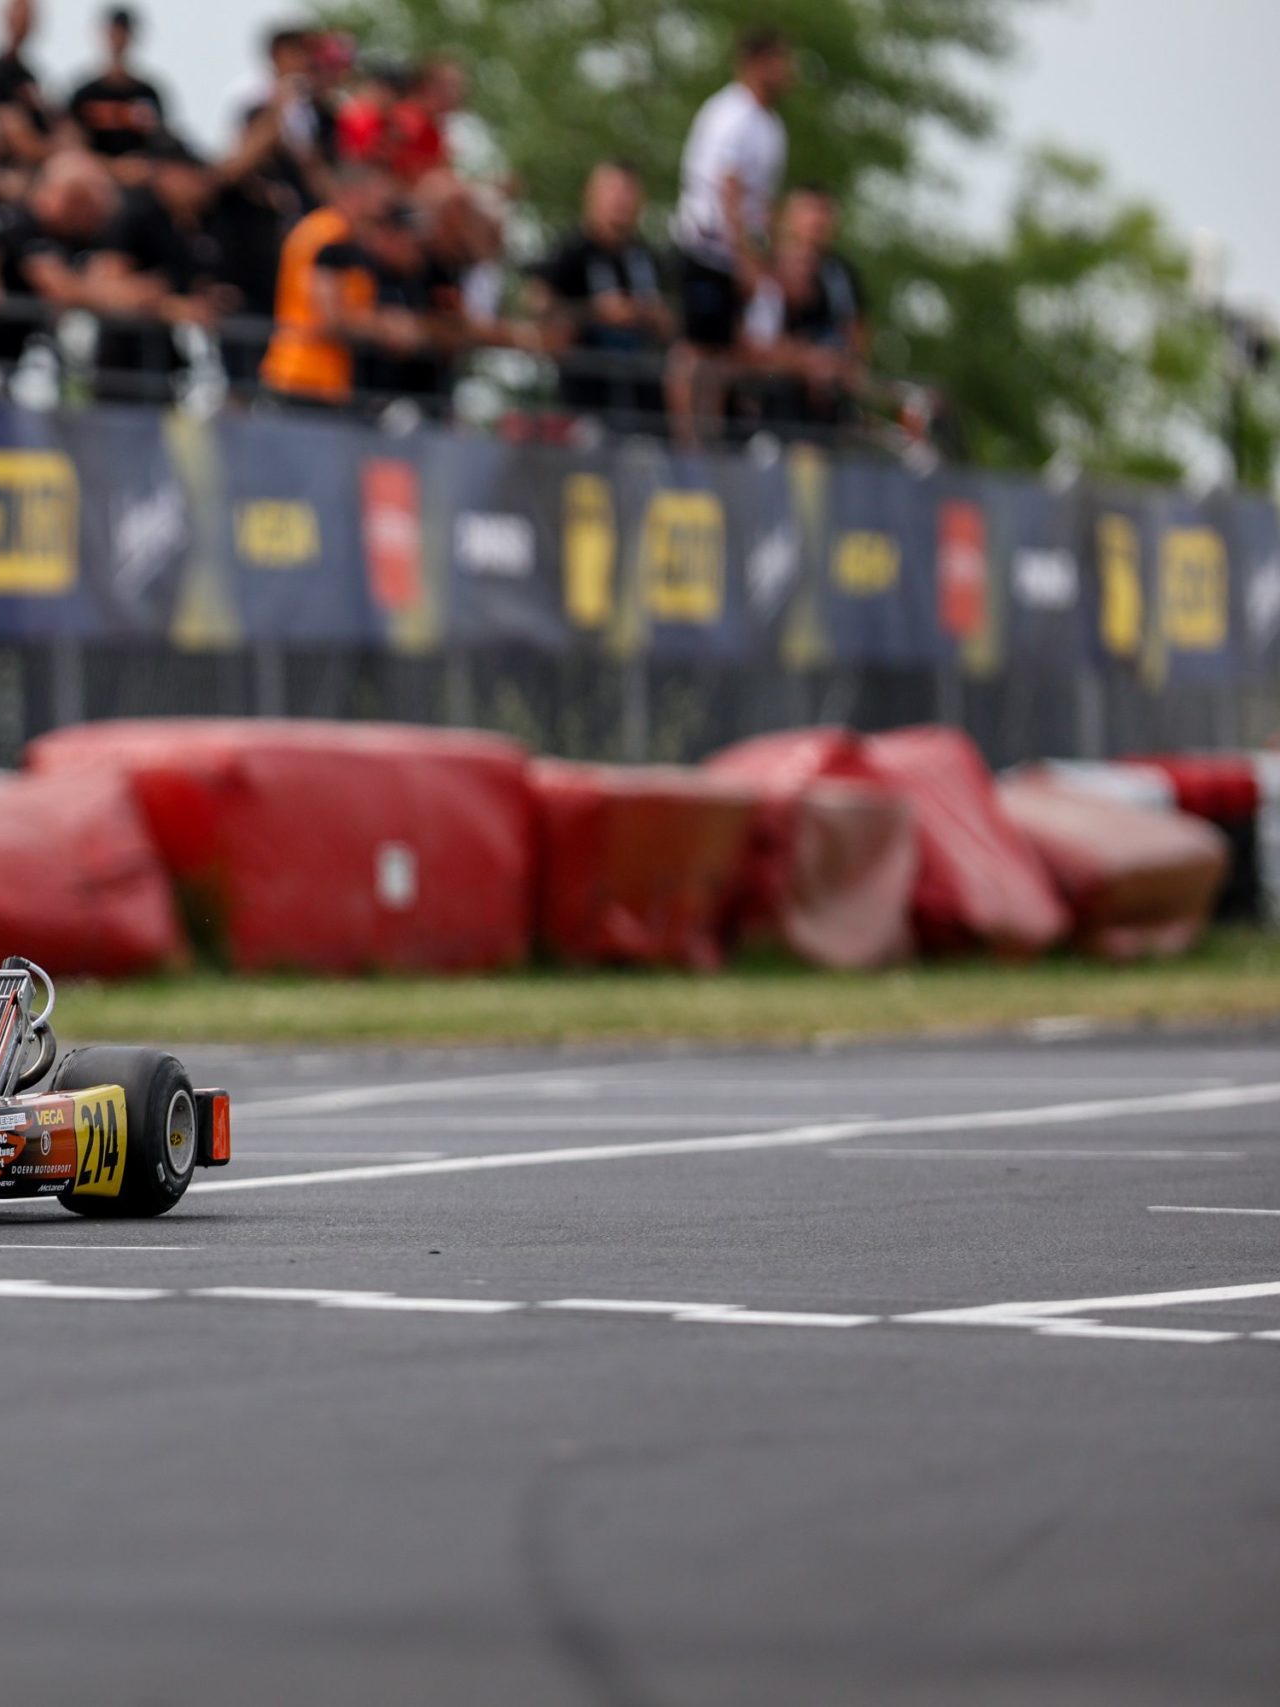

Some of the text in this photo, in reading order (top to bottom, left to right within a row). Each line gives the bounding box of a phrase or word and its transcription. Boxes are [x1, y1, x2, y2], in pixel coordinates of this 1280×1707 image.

[36, 1109, 64, 1126] VEGA
[77, 1101, 119, 1188] 214
[11, 1164, 72, 1174] DOERR MOTORSPORT
[38, 1184, 65, 1192] McLaren
